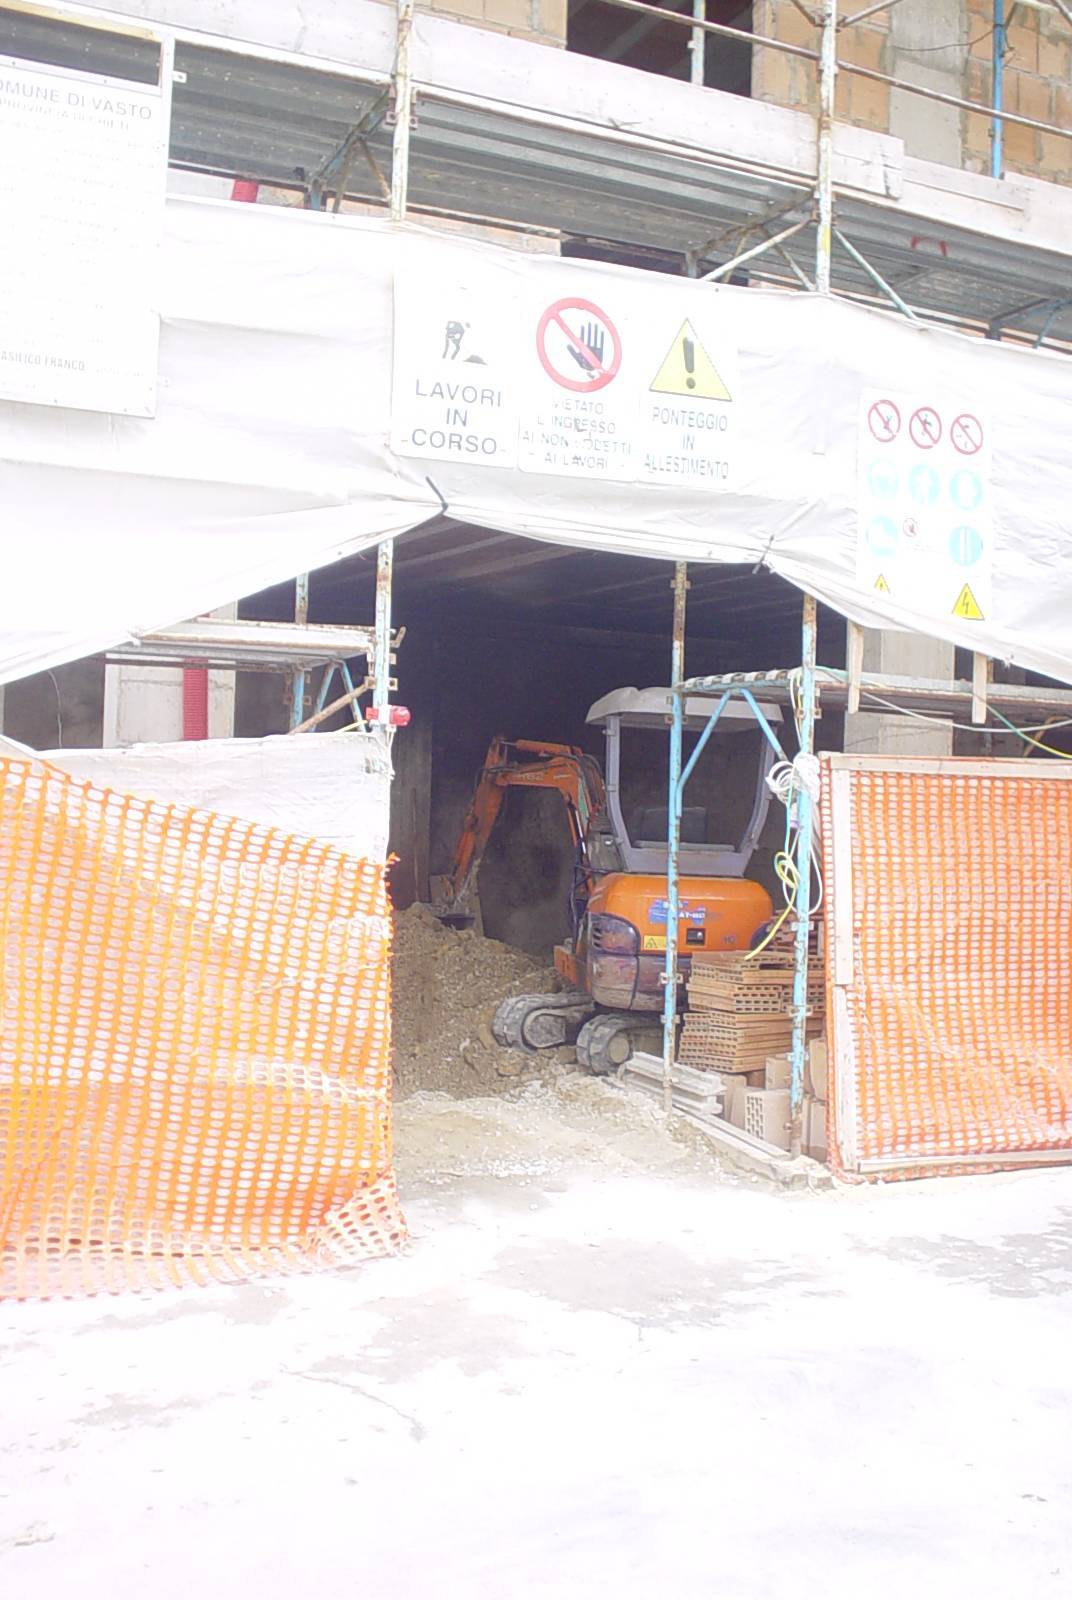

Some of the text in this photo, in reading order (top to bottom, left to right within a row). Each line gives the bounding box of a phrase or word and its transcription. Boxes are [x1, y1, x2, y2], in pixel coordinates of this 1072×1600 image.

[68, 92, 85, 107] DI
[92, 96, 152, 119] VASTO
[0, 350, 41, 366] ASILICO
[415, 378, 502, 408] LAVORI
[446, 408, 468, 428] IN
[651, 406, 728, 432] PONTEGGIO
[411, 428, 497, 455] CORSO
[541, 432, 569, 447] NON
[575, 437, 631, 456] DDETTI
[682, 434, 695, 450] IN
[544, 452, 608, 470] AI LAVORI
[644, 453, 729, 479] ALLESTIMENTO
